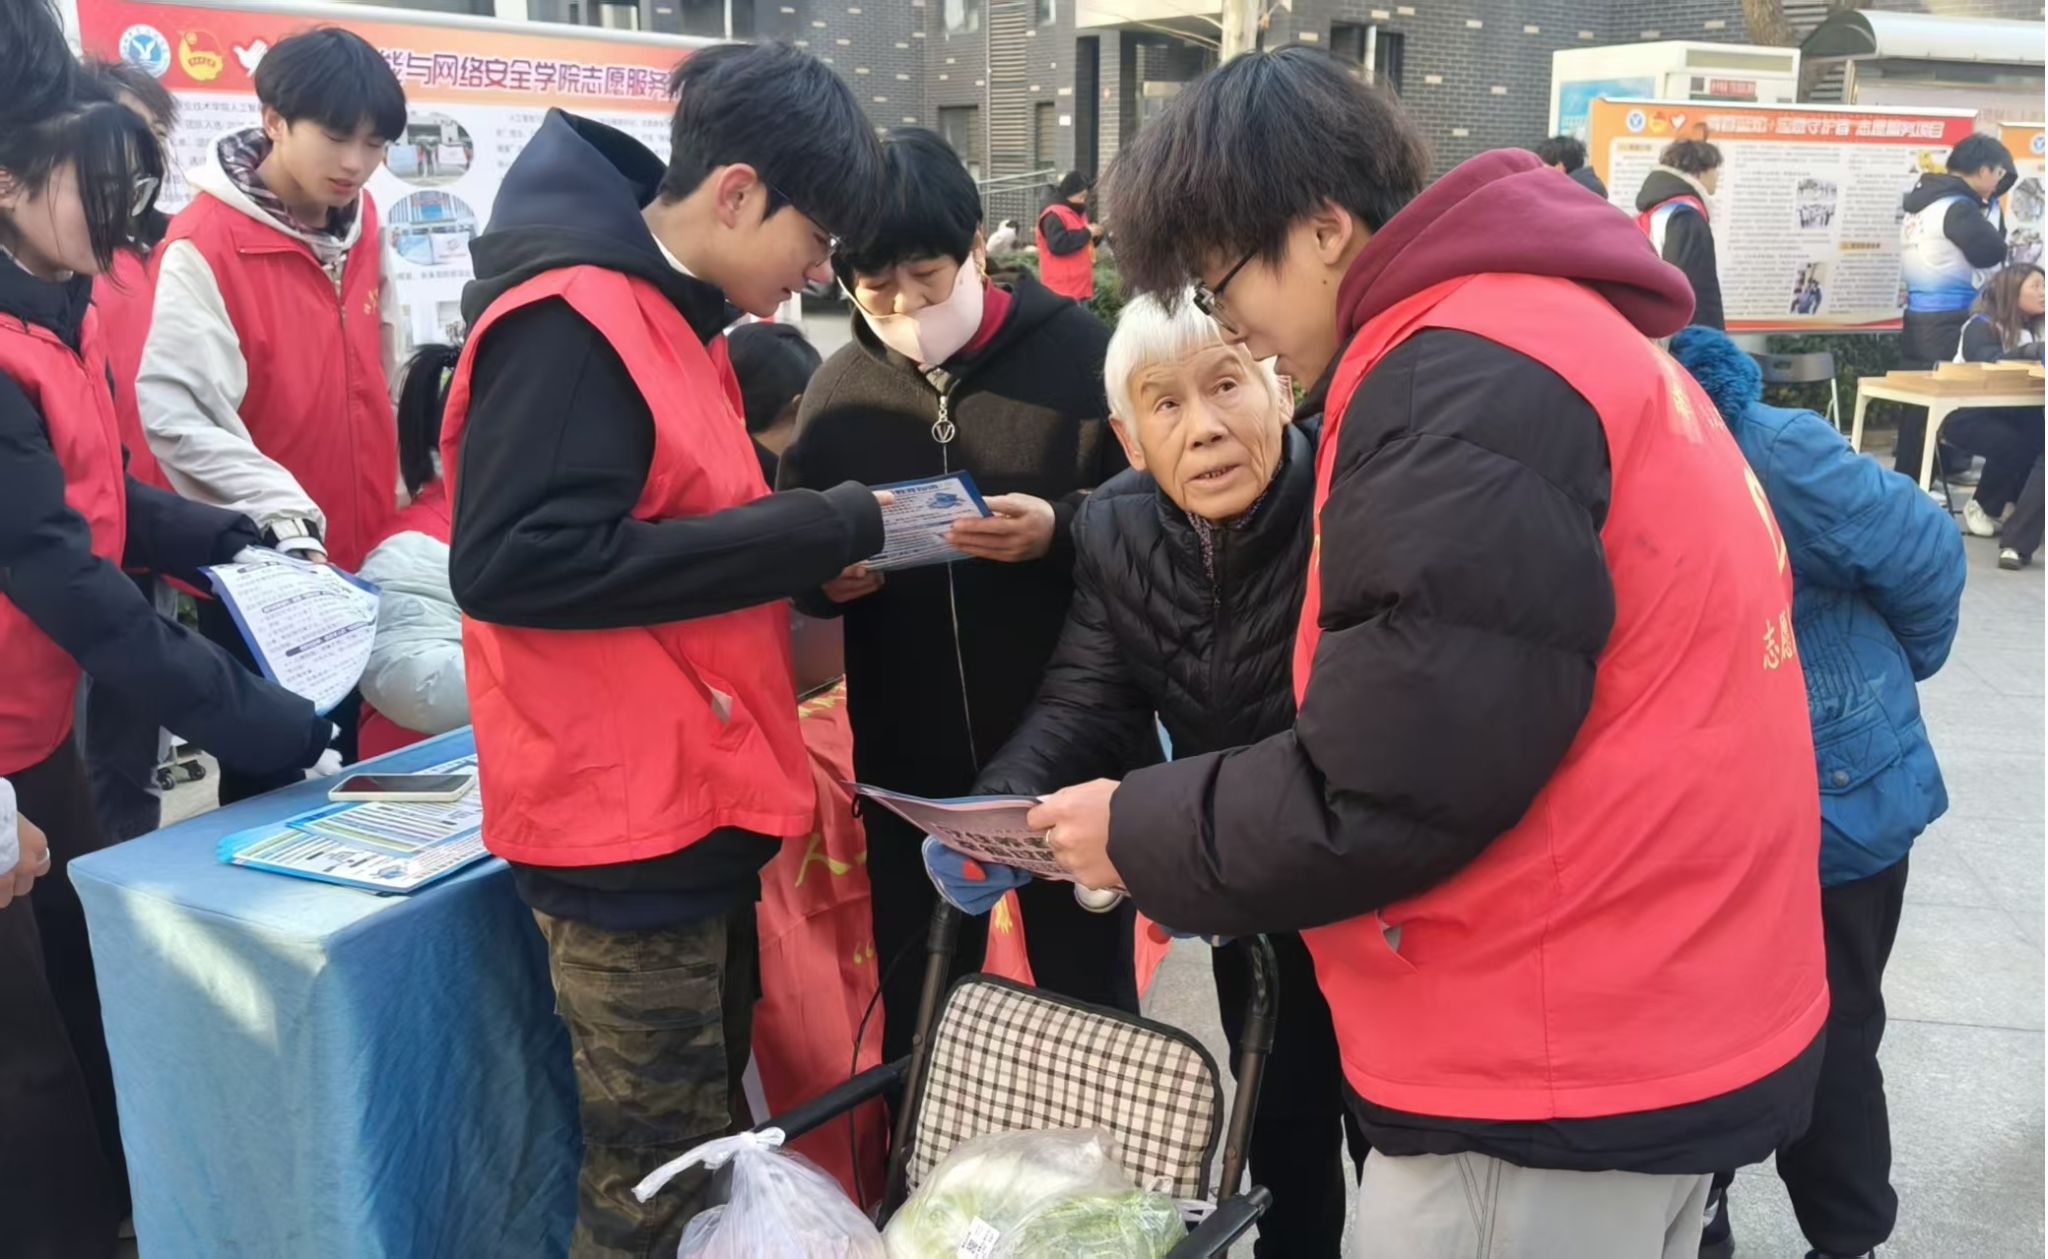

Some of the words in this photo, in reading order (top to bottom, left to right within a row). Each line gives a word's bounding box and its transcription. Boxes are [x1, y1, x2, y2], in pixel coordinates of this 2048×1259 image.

[379, 50, 681, 99] 与网络安全学院志愿服务
[1763, 606, 1796, 671] 志愿
